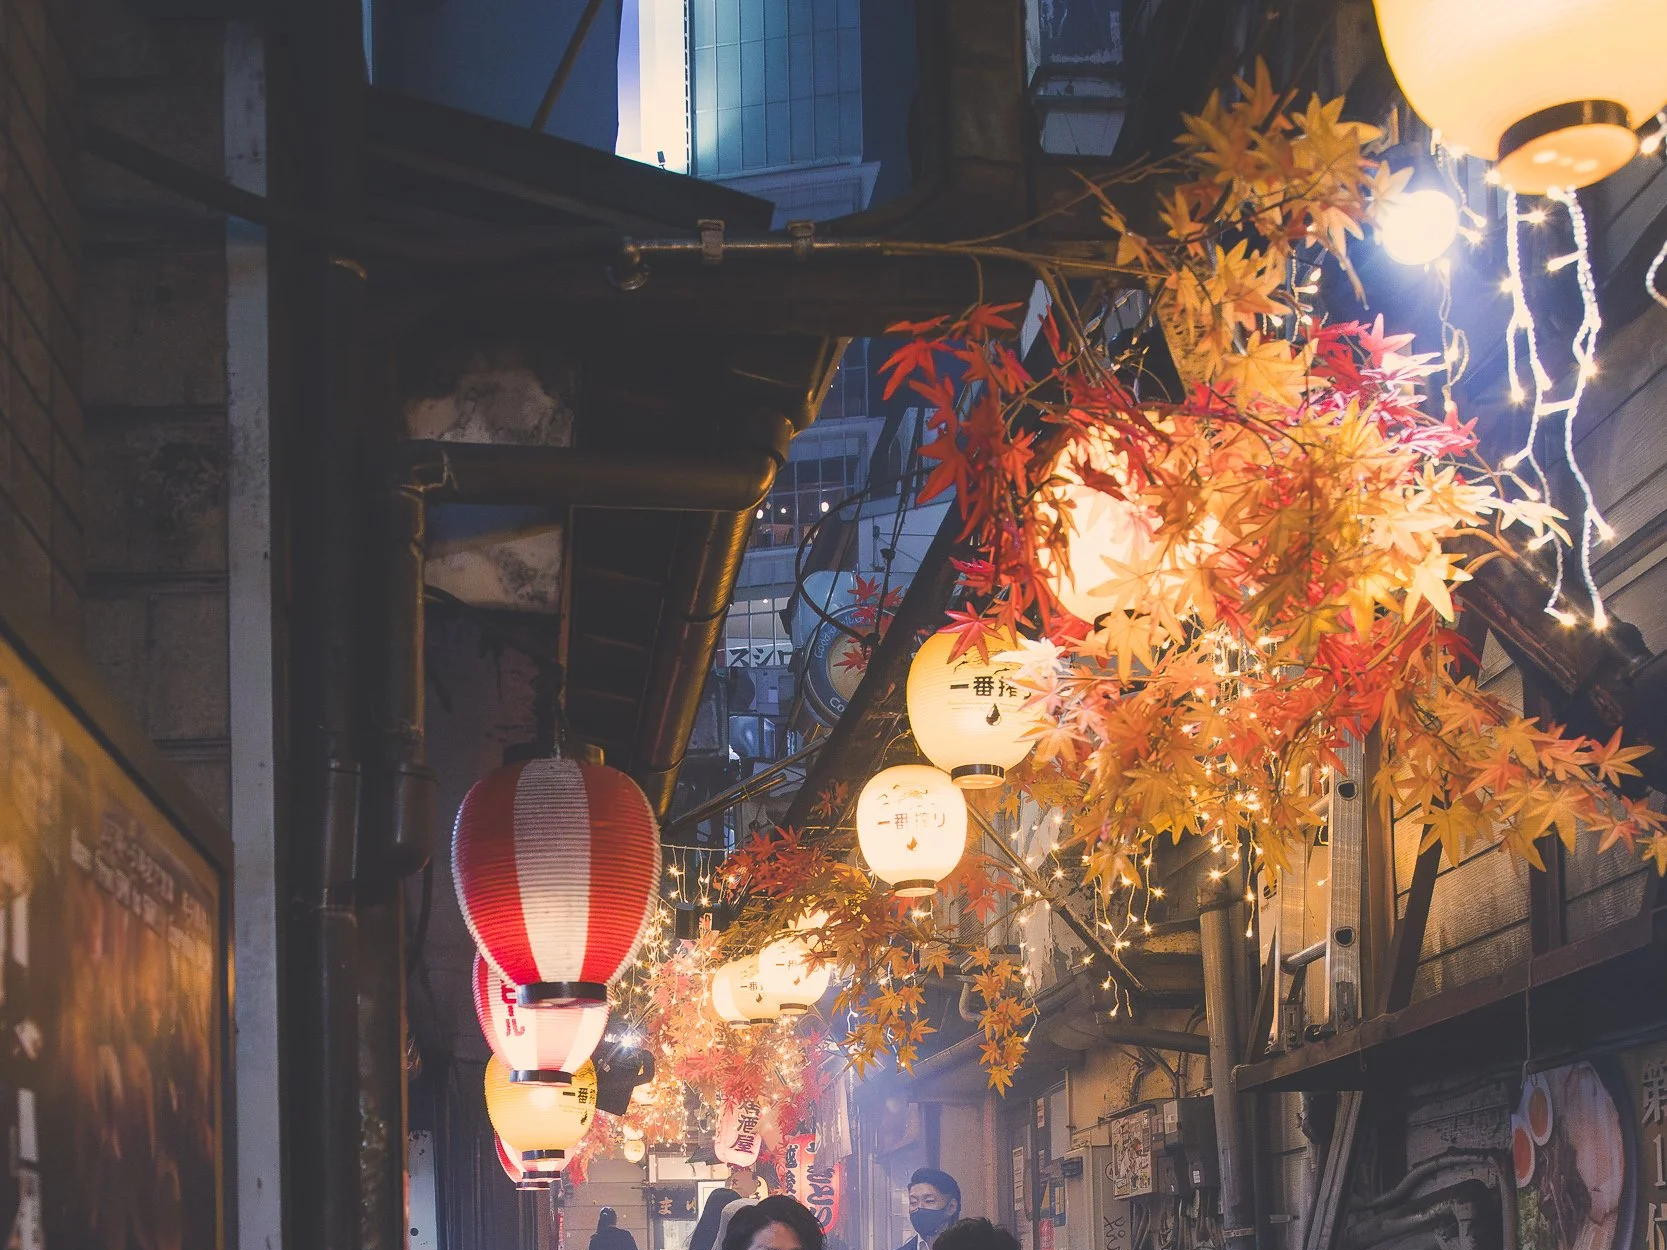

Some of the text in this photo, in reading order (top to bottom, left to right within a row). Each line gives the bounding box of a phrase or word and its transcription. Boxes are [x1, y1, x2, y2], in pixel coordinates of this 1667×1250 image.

[950, 676, 1032, 700] 一番搾
[805, 1141, 836, 1228] きとり
